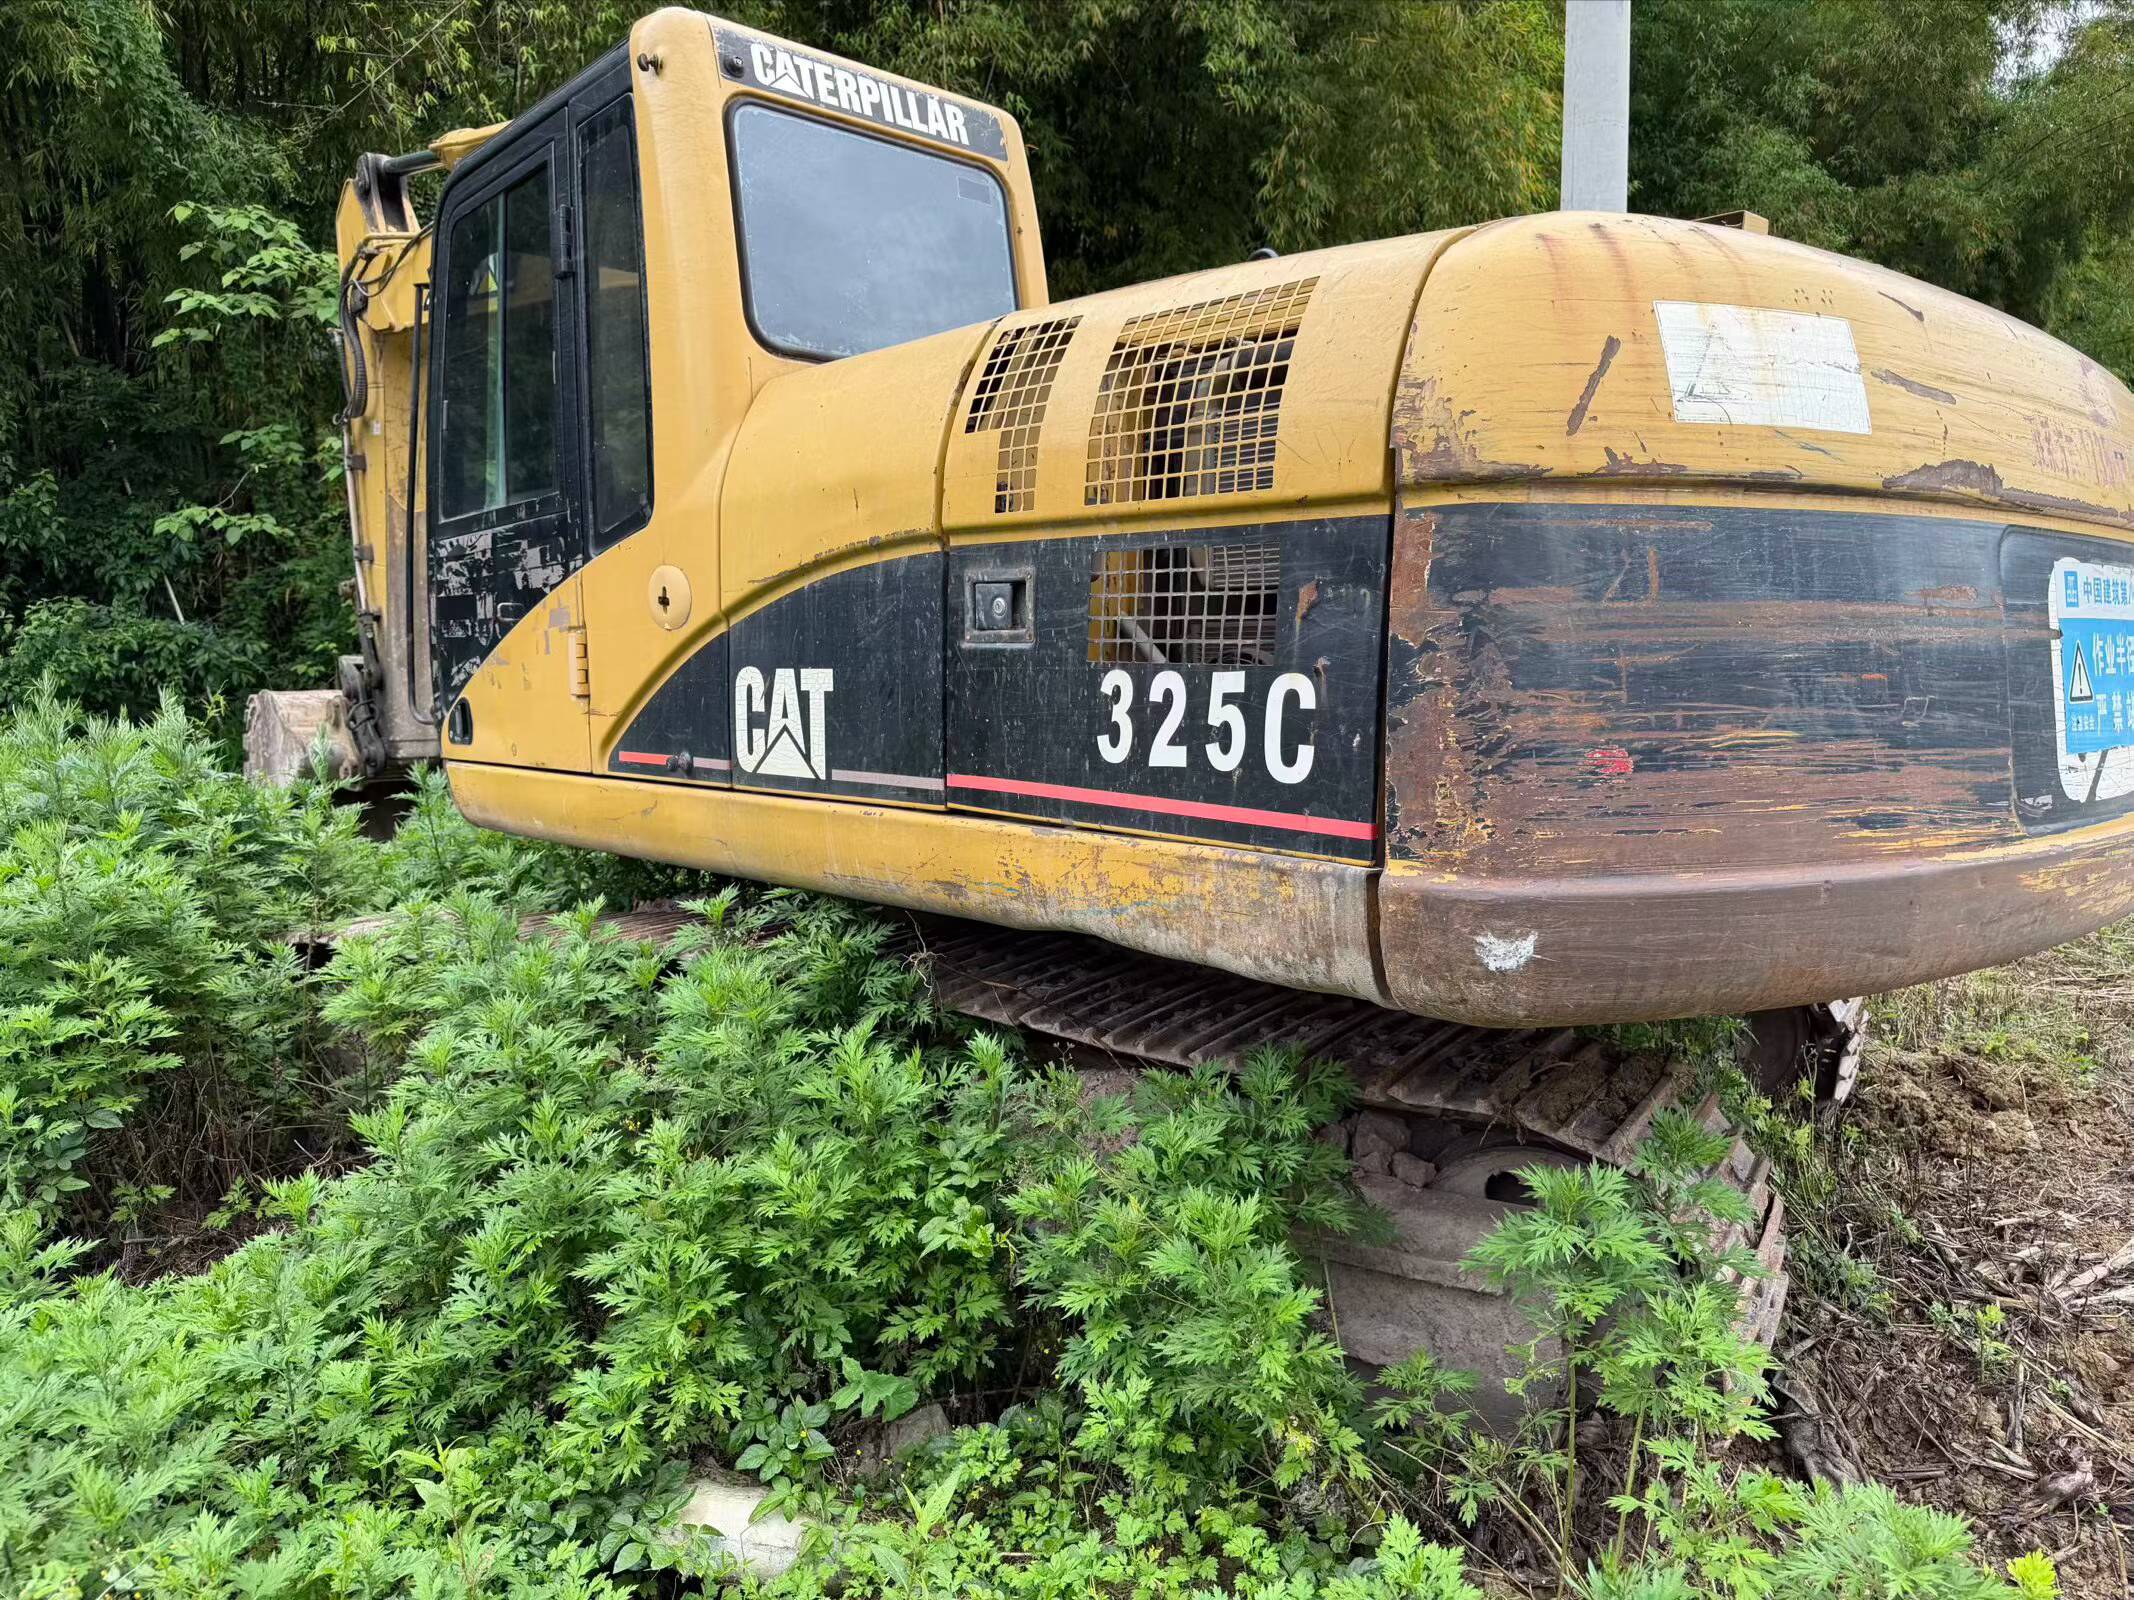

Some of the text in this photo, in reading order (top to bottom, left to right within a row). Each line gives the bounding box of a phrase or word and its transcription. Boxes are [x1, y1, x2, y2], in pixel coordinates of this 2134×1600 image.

[751, 42, 969, 145] CATERPILLAR
[735, 666, 834, 780] CAT
[1097, 669, 1316, 784] 325C
